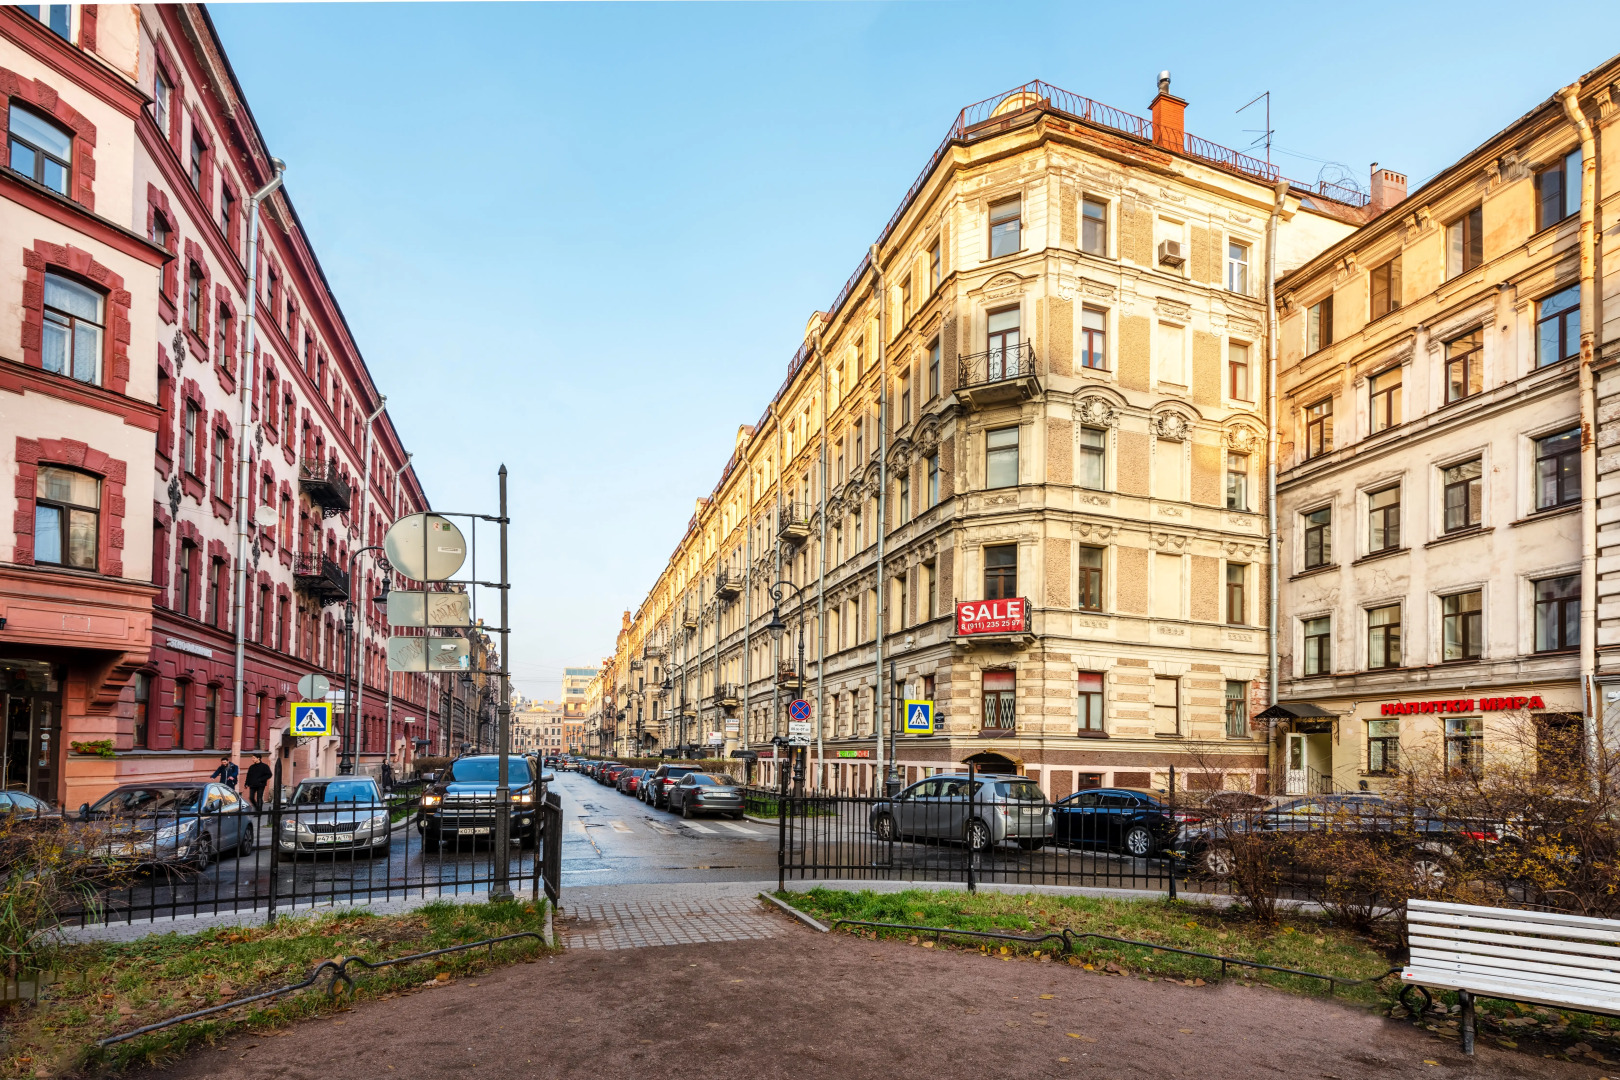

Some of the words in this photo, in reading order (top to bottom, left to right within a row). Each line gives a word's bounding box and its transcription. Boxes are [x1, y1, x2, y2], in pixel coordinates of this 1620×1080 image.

[961, 601, 1020, 622] SALE
[967, 622, 984, 630] (911)
[1381, 699, 1474, 715] НАПИТКИ
[1479, 696, 1546, 711] МИРА
